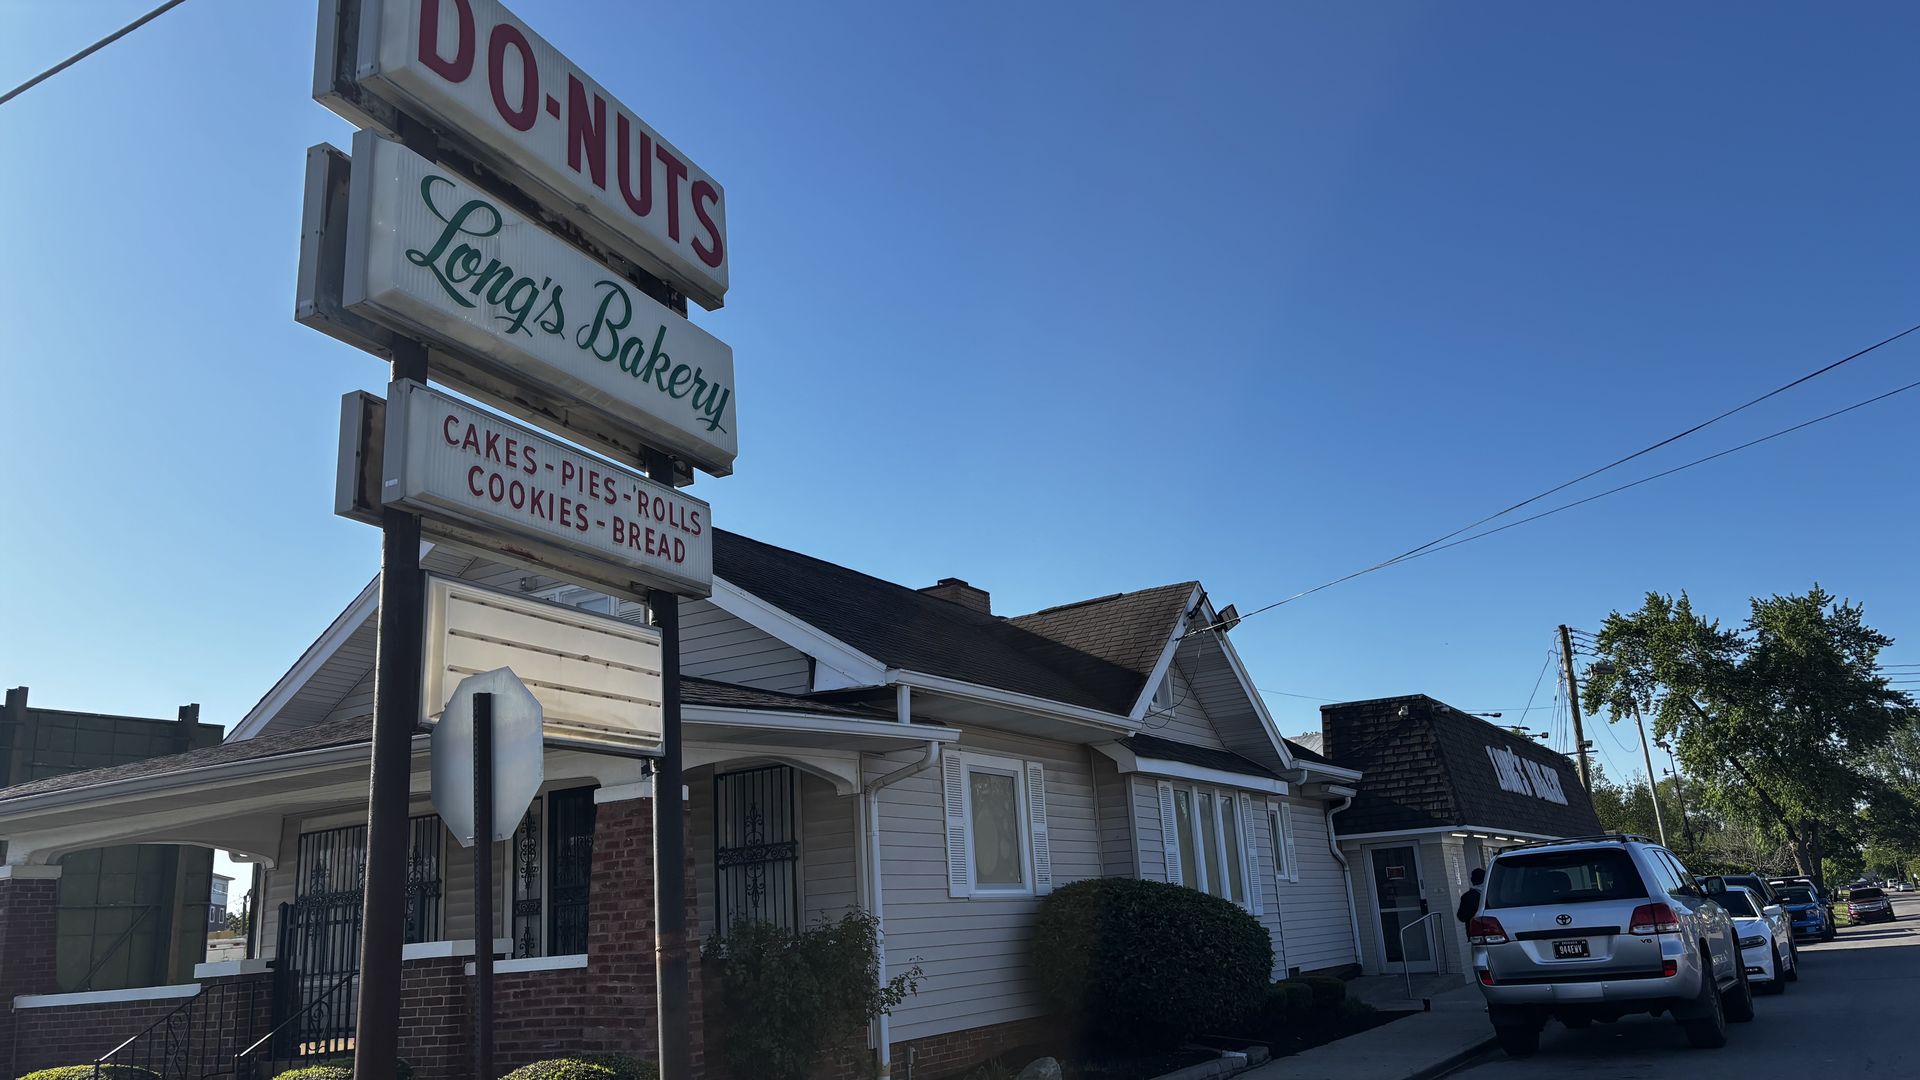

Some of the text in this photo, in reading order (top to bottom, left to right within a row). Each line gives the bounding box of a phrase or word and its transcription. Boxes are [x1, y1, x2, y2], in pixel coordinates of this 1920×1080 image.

[418, 0, 723, 268] DO-NUTS
[405, 175, 731, 434] Long's Bakery
